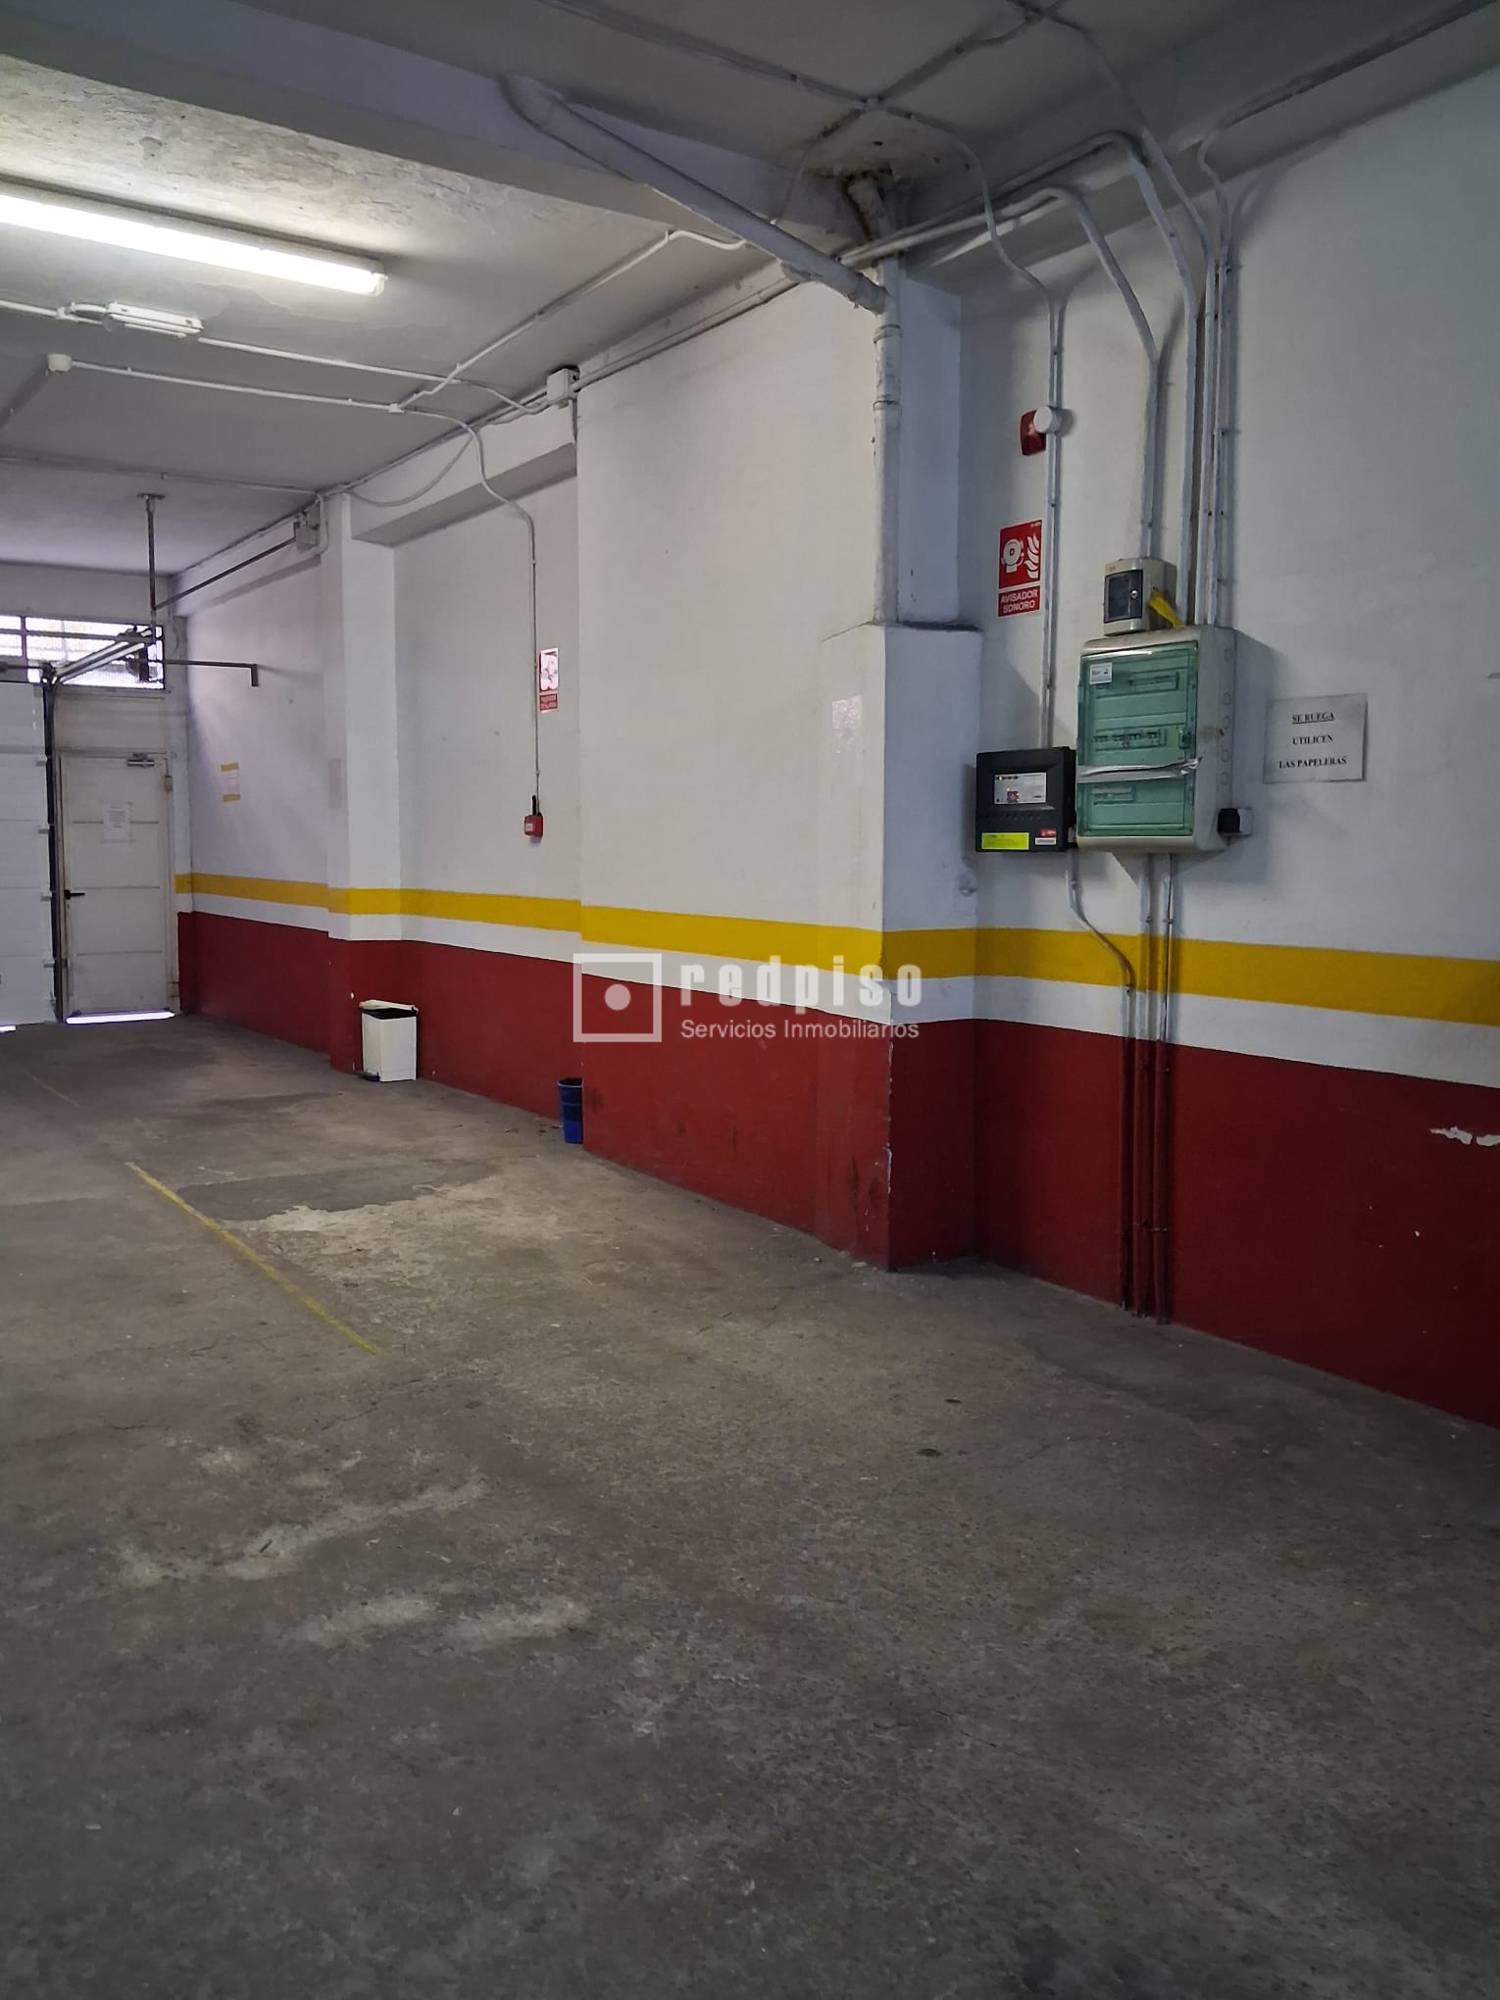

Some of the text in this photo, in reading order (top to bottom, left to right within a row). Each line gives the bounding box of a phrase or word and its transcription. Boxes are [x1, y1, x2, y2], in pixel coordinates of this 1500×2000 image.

[1001, 589, 1038, 603] AVISADOR
[1003, 600, 1036, 613] SONORO
[1292, 712, 1335, 722] SE RUEGA
[1292, 735, 1334, 745] UTILICEN
[1279, 757, 1347, 769] LAS PAPELERAS
